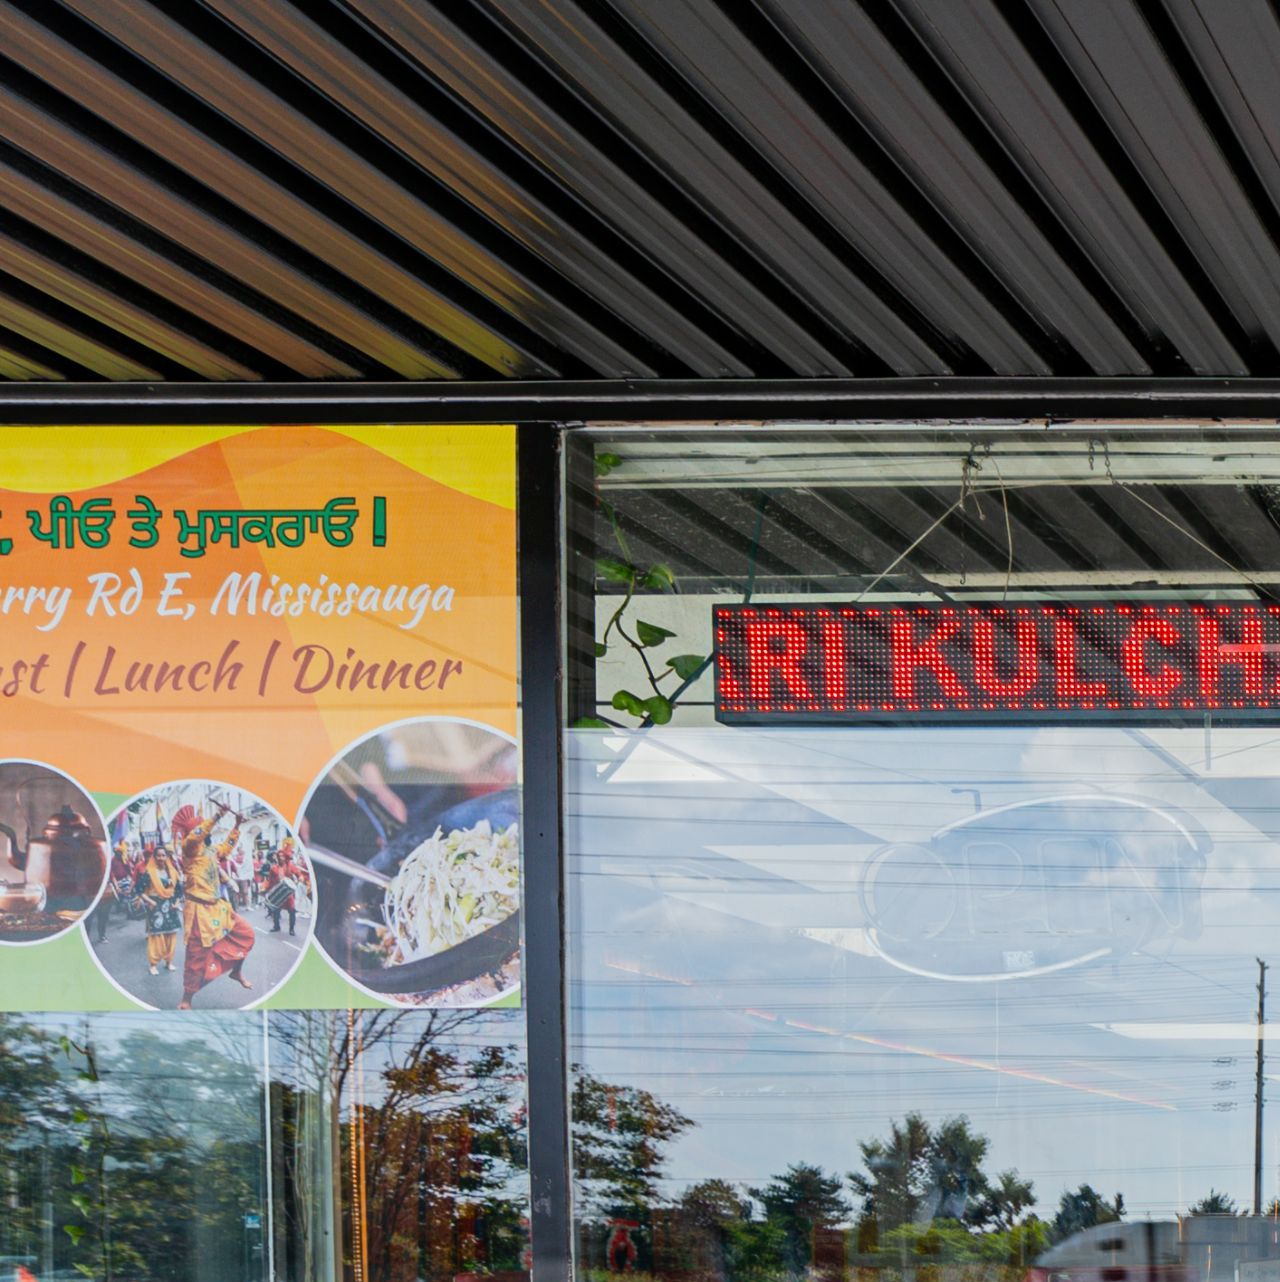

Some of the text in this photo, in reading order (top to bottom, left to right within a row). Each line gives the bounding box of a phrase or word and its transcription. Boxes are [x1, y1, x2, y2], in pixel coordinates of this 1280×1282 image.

[126, 495, 162, 549] ਤੇ
[86, 567, 144, 617] Rd
[157, 571, 196, 621] E,
[210, 571, 456, 630] Mississauga
[95, 640, 241, 696] Lunch
[292, 643, 463, 696] Dinner
